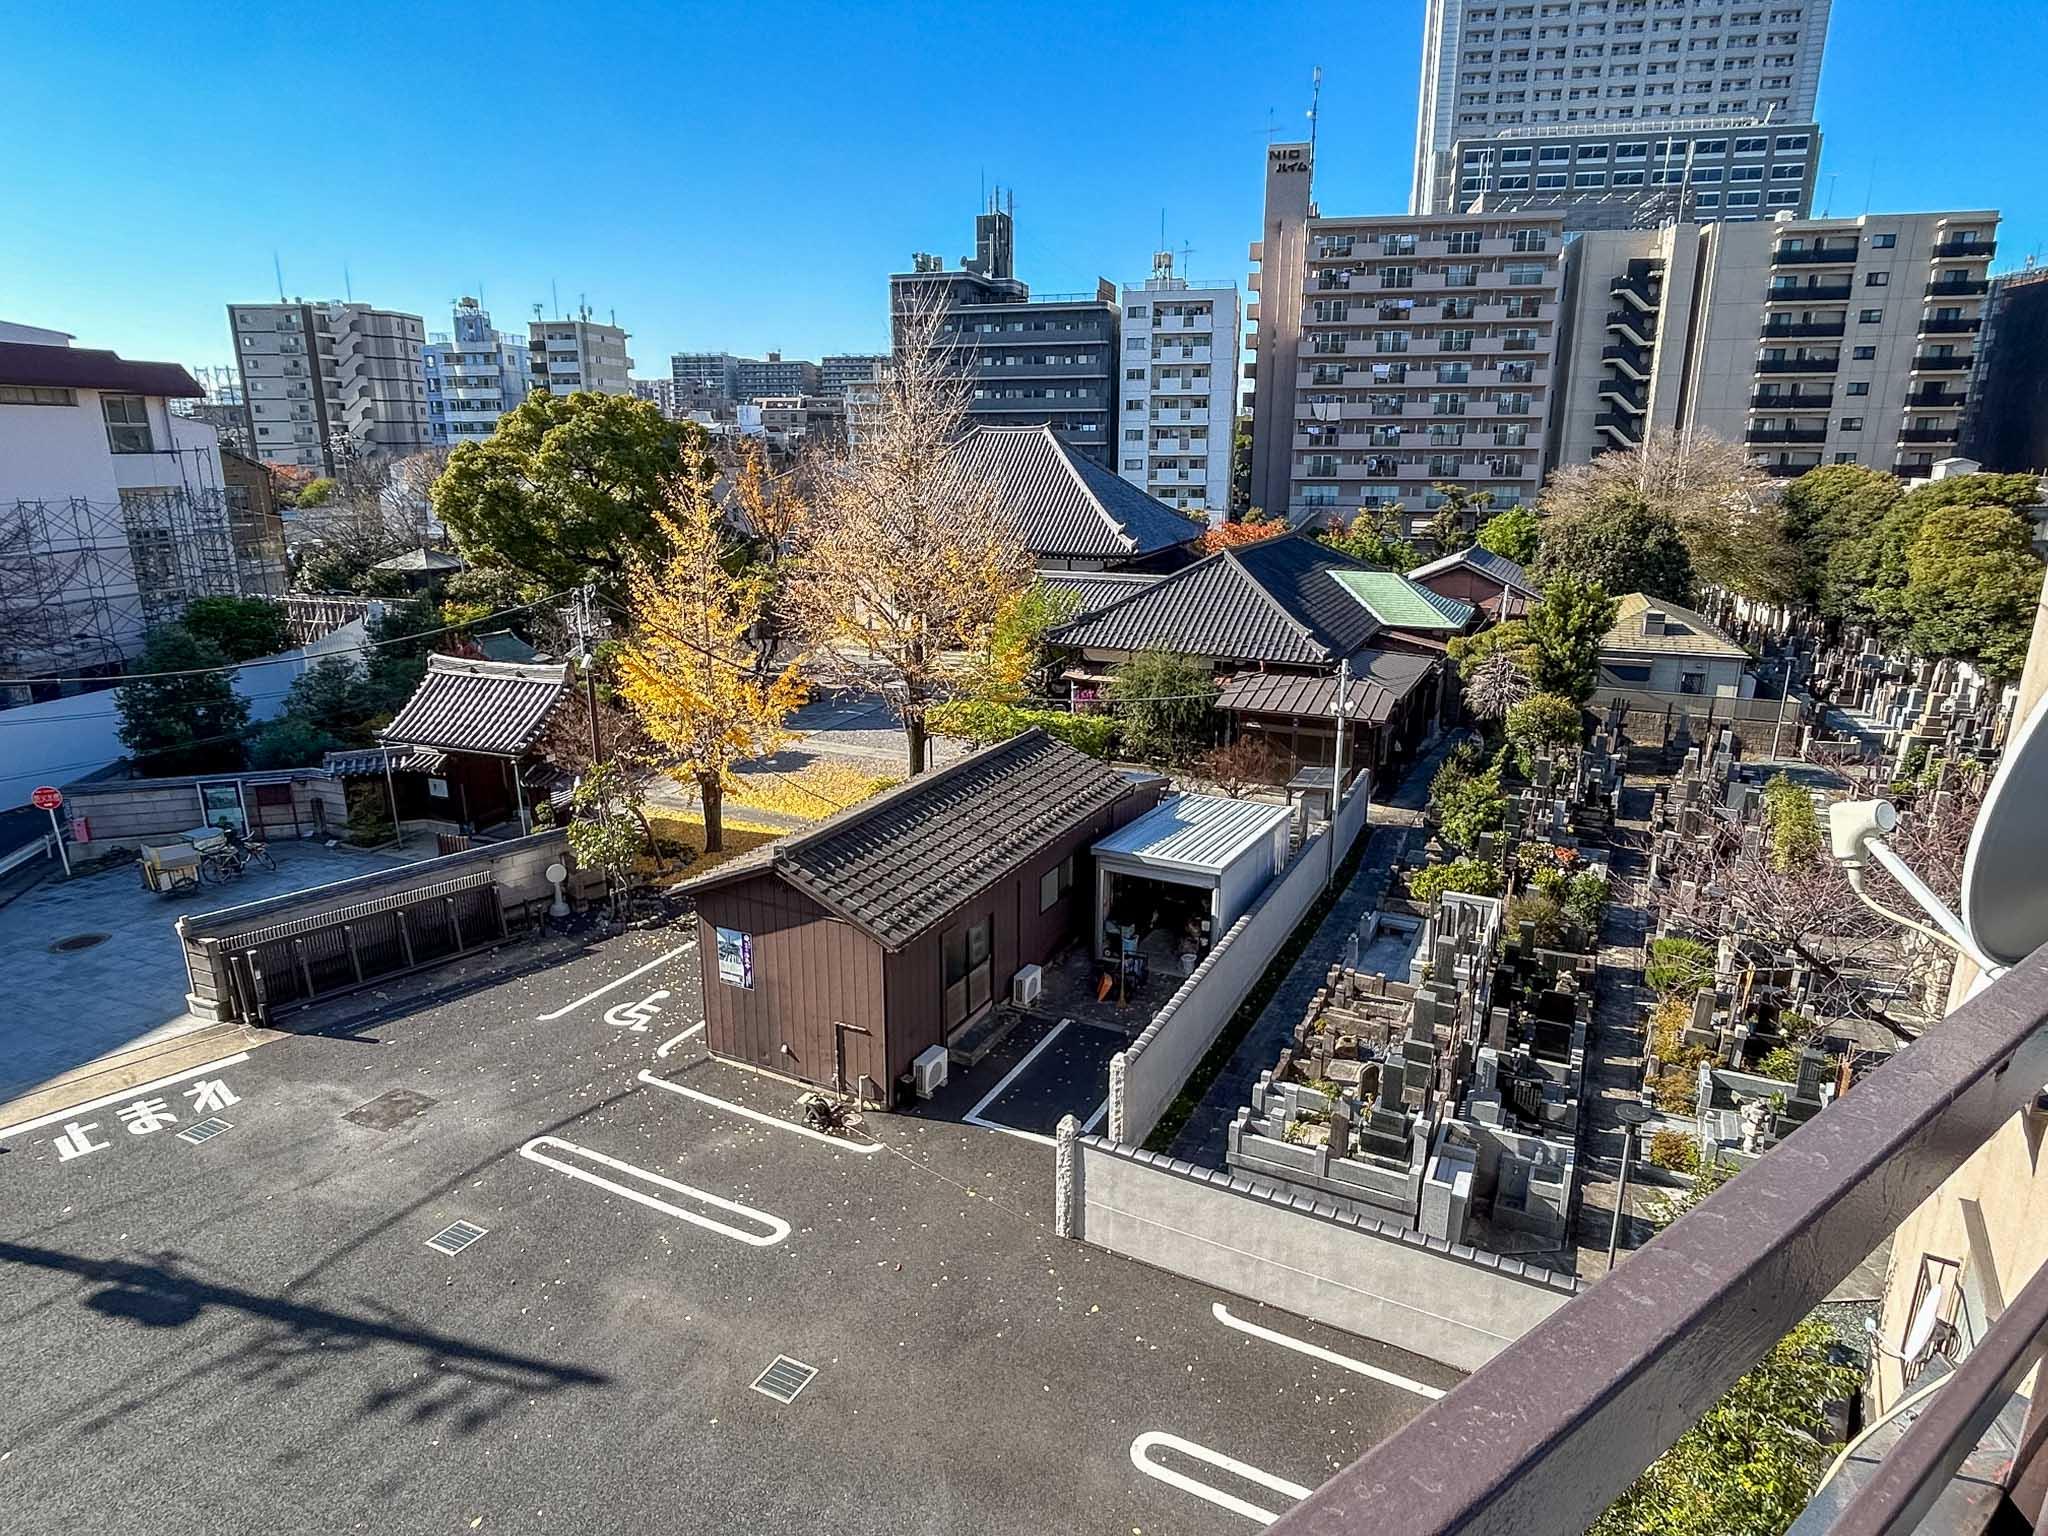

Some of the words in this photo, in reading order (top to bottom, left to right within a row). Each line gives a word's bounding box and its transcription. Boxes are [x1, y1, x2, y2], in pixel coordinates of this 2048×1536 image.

[1276, 162, 1308, 173] ハイム
[53, 1079, 242, 1162] 止まれ
